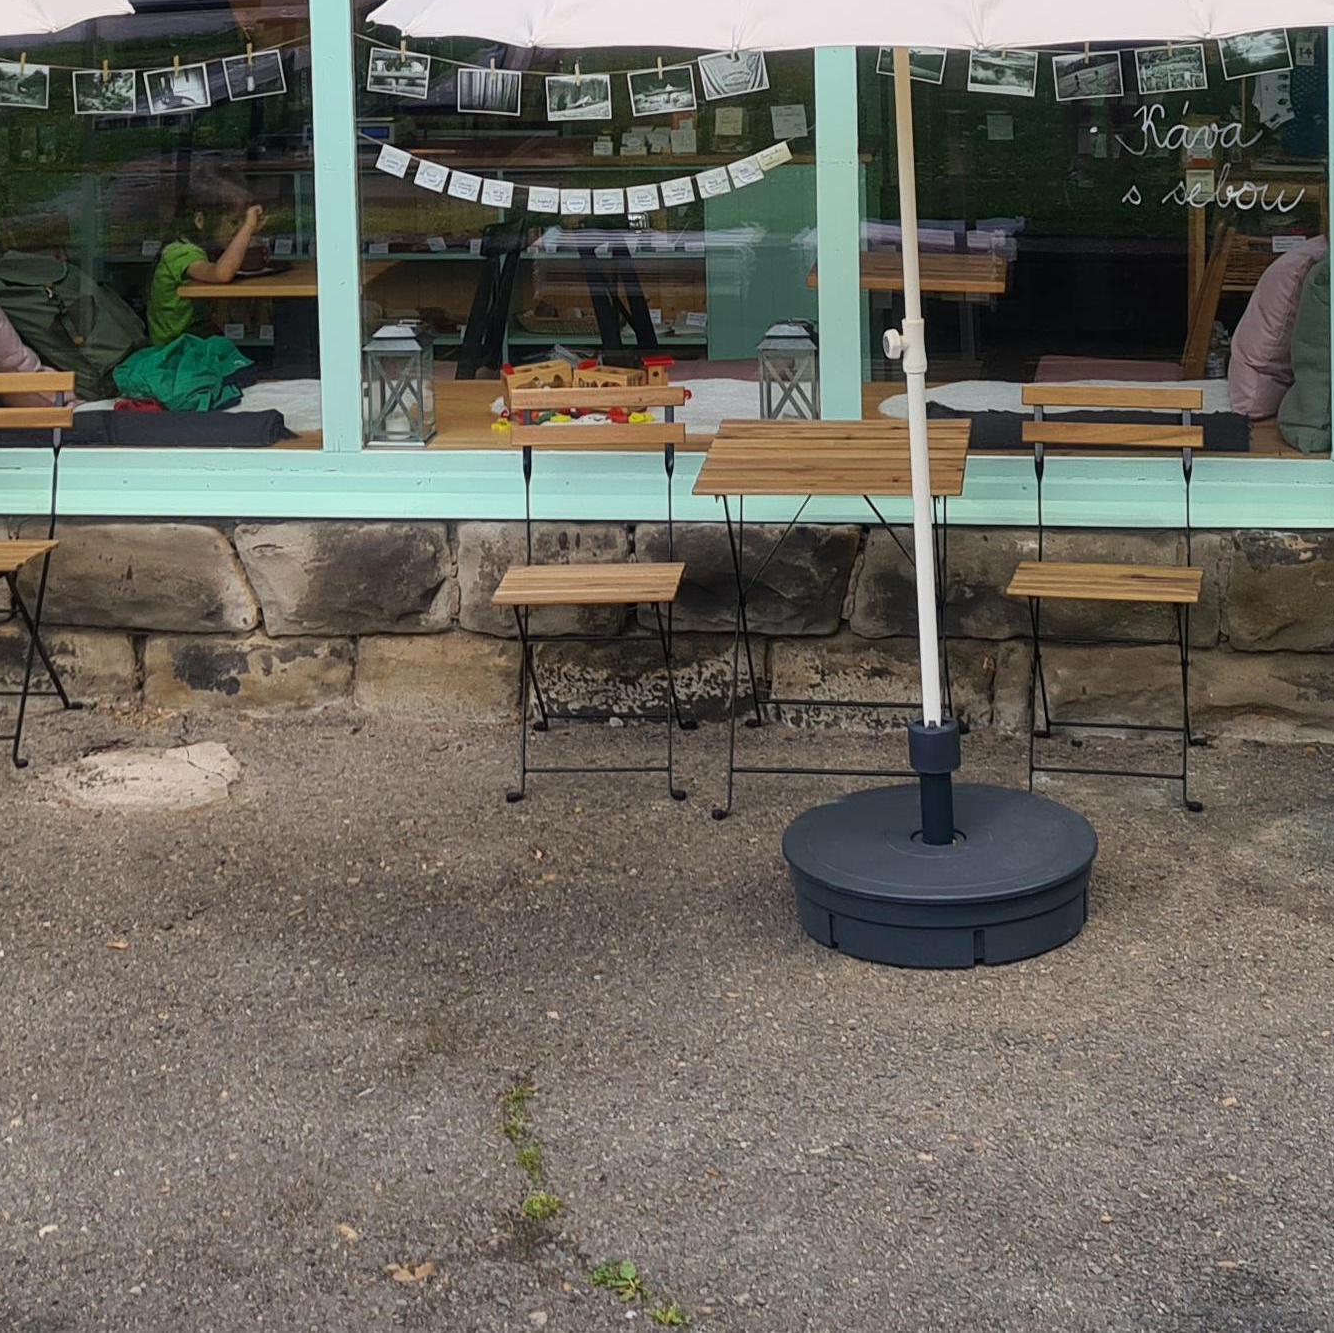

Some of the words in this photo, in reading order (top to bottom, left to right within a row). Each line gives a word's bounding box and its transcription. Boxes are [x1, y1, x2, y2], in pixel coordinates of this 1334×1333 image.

[1114, 100, 1263, 156] Káva
[1121, 183, 1142, 206] s
[1162, 163, 1305, 213] sebou
